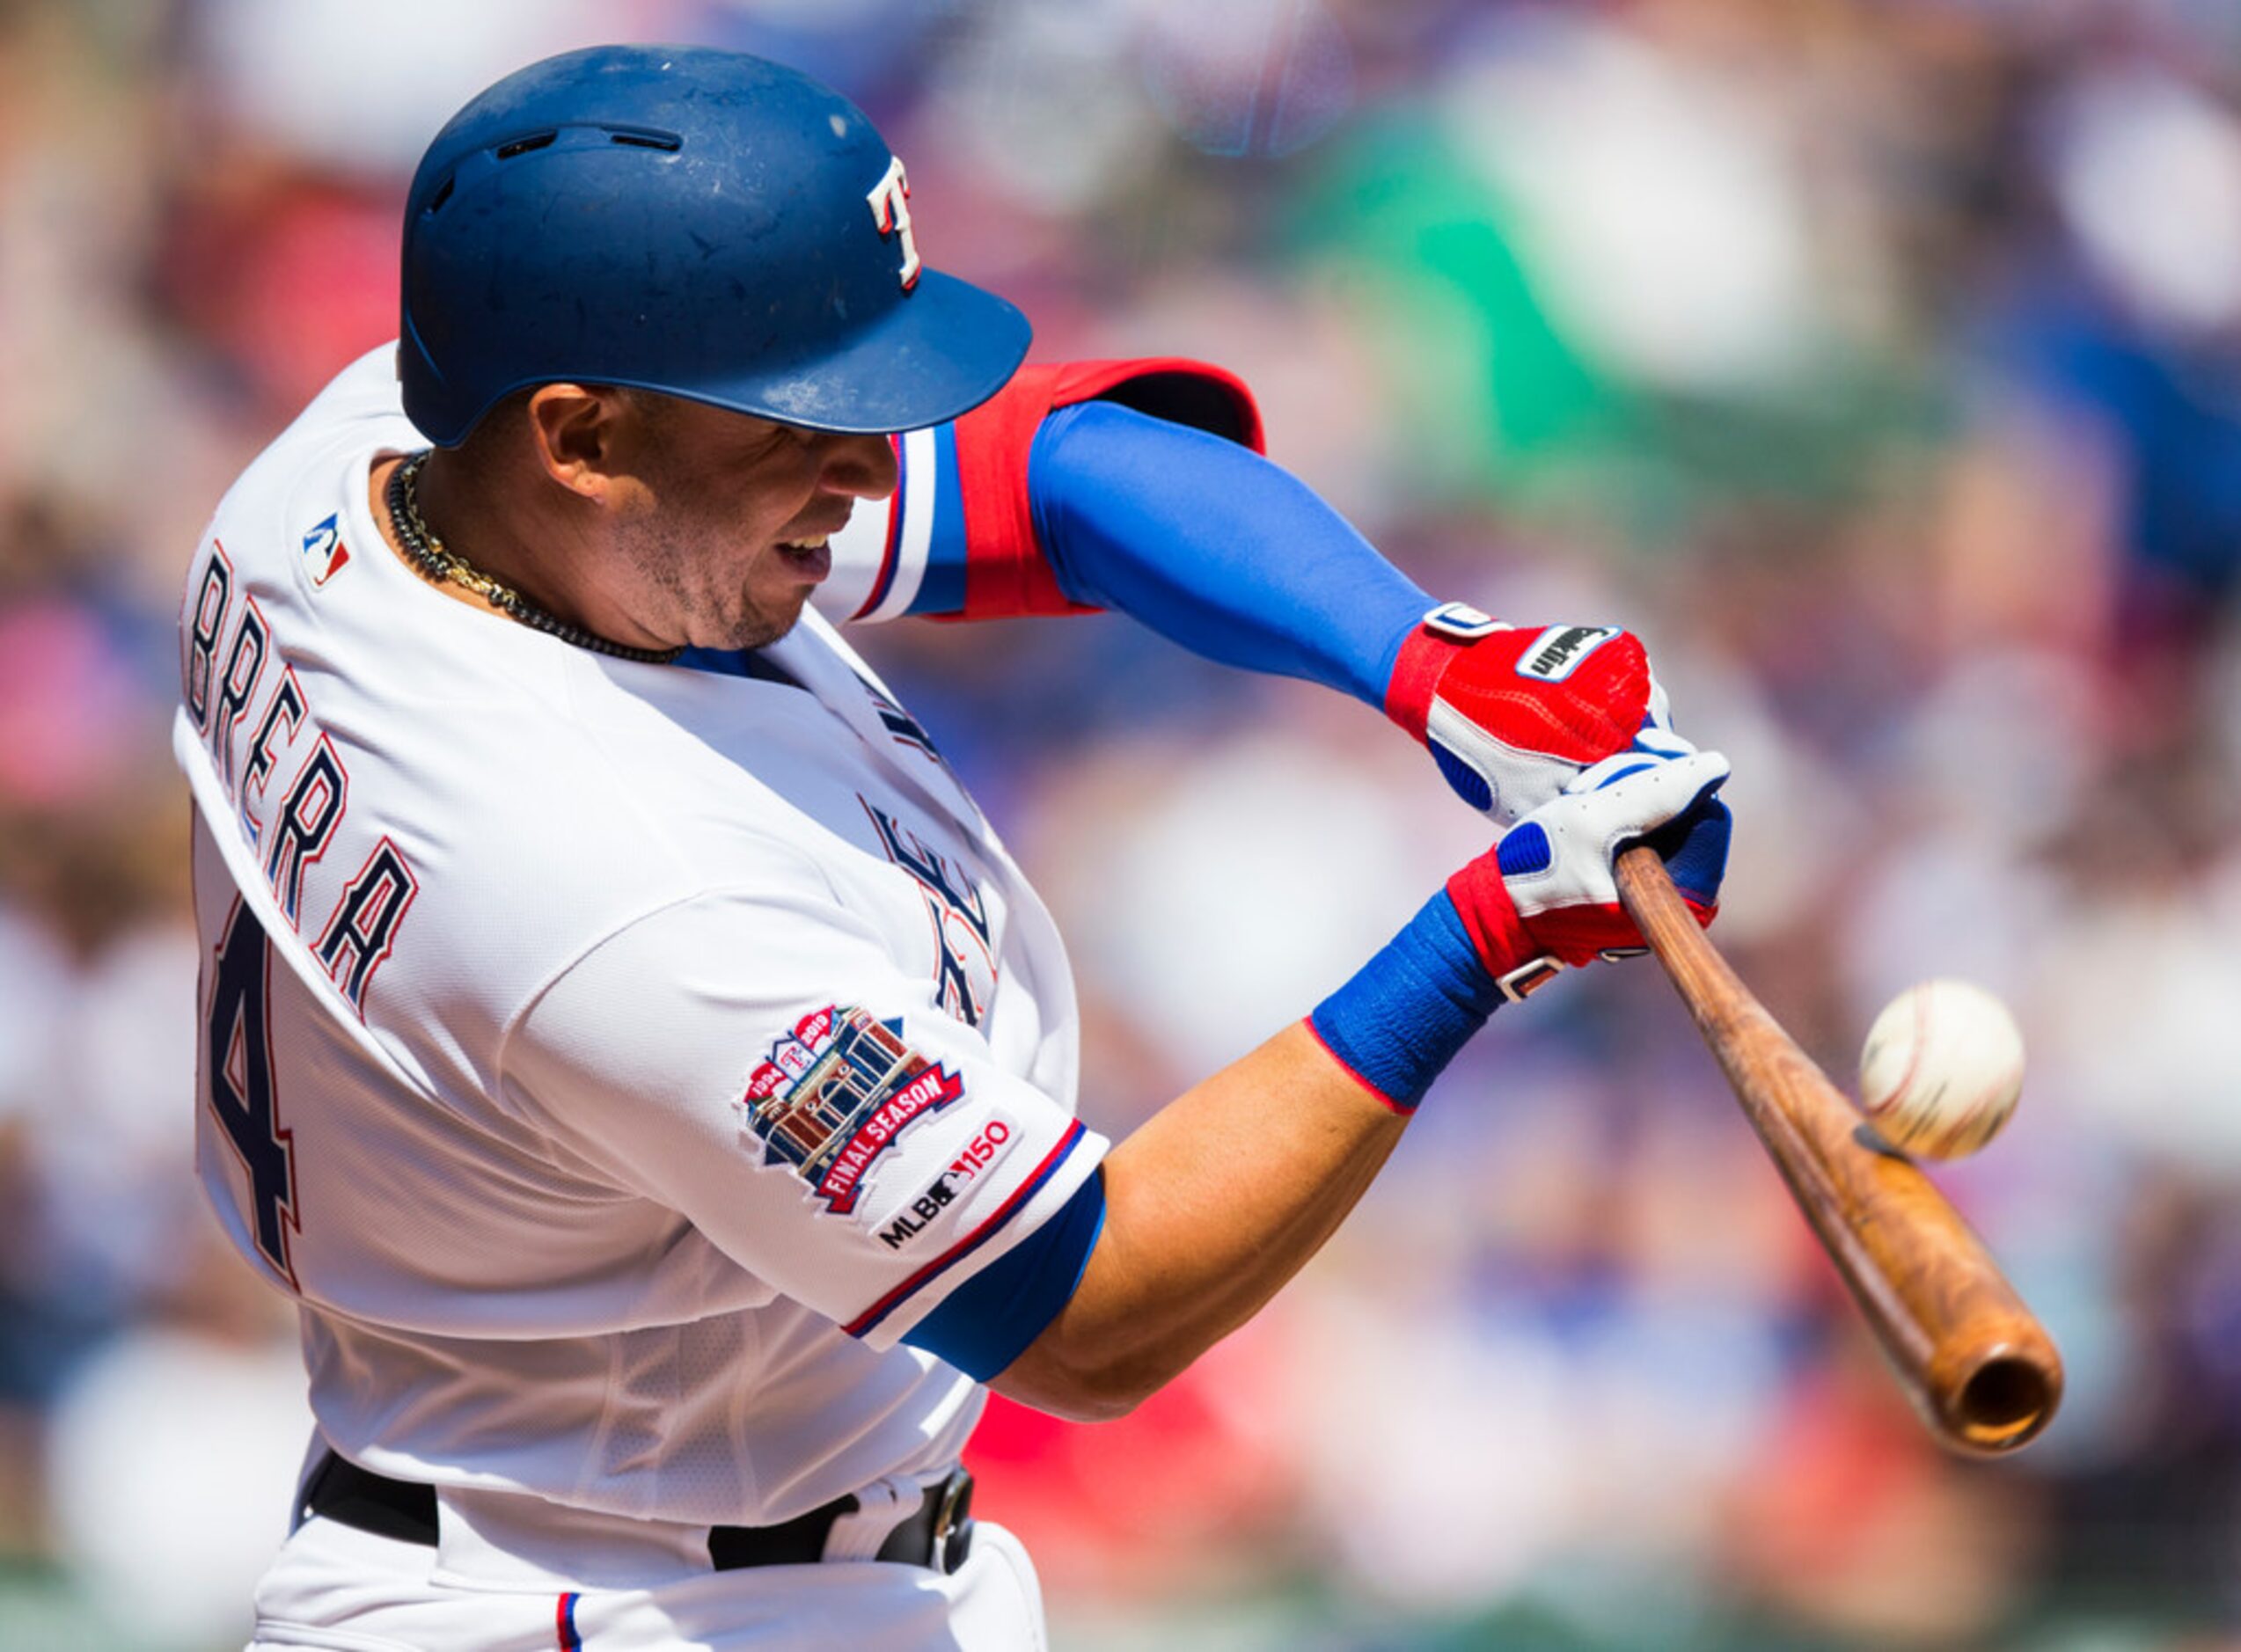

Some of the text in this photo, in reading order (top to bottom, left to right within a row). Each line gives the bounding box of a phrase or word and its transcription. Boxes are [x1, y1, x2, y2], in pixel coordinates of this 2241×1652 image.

[866, 155, 922, 290] T
[751, 1067, 783, 1096] 1994
[800, 1012, 829, 1045] 2019
[825, 1073, 943, 1195] FINAL SEASON
[878, 1120, 1010, 1250] MLB 150
